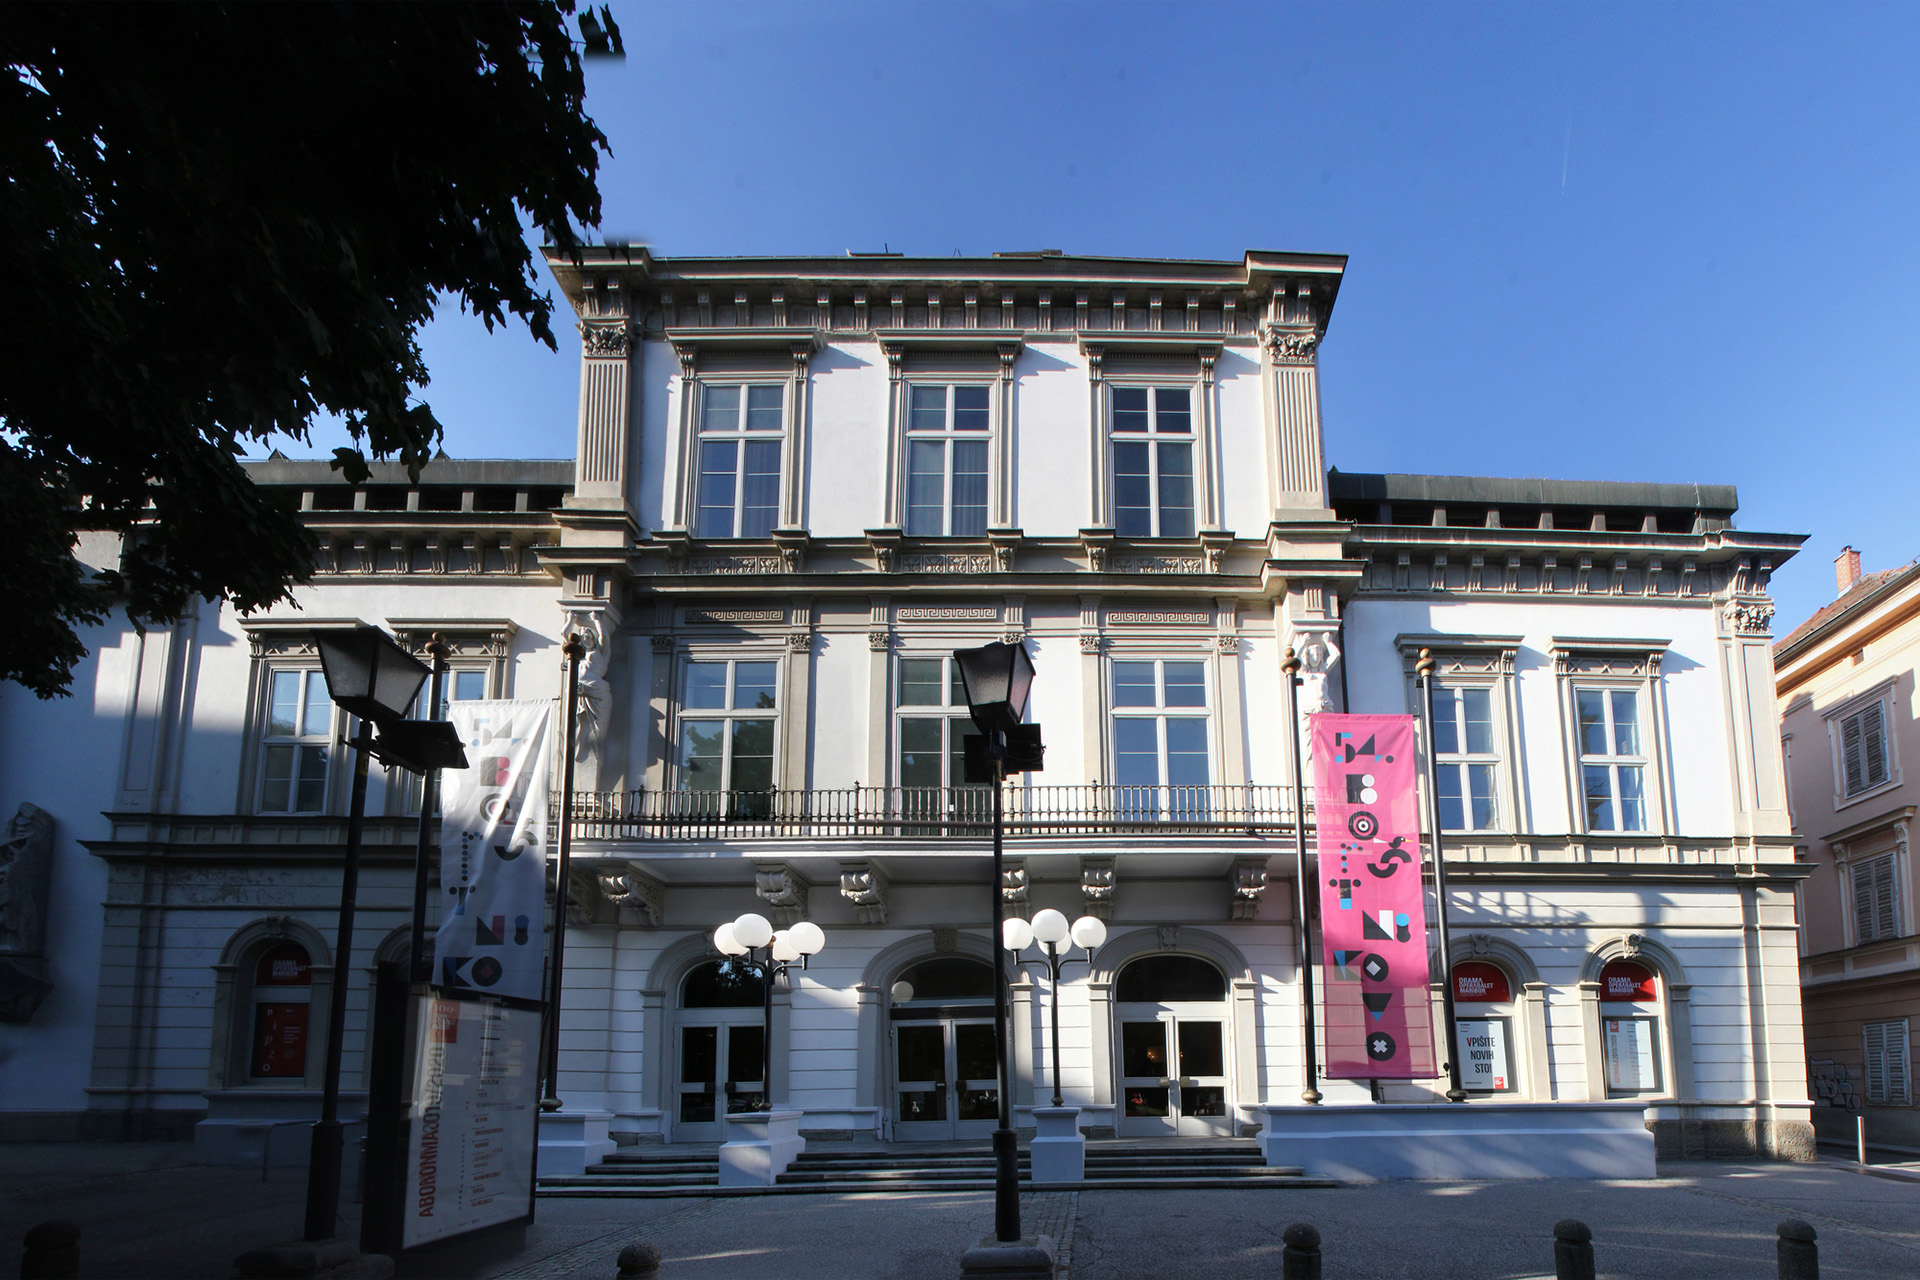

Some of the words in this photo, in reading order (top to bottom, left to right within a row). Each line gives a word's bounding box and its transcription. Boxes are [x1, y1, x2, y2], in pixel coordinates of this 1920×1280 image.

[1335, 732, 1394, 764] 54.
[1466, 1036, 1495, 1047] VPIŠITE
[1470, 1050, 1494, 1060] NOVIH
[1475, 1063, 1492, 1073] STO!
